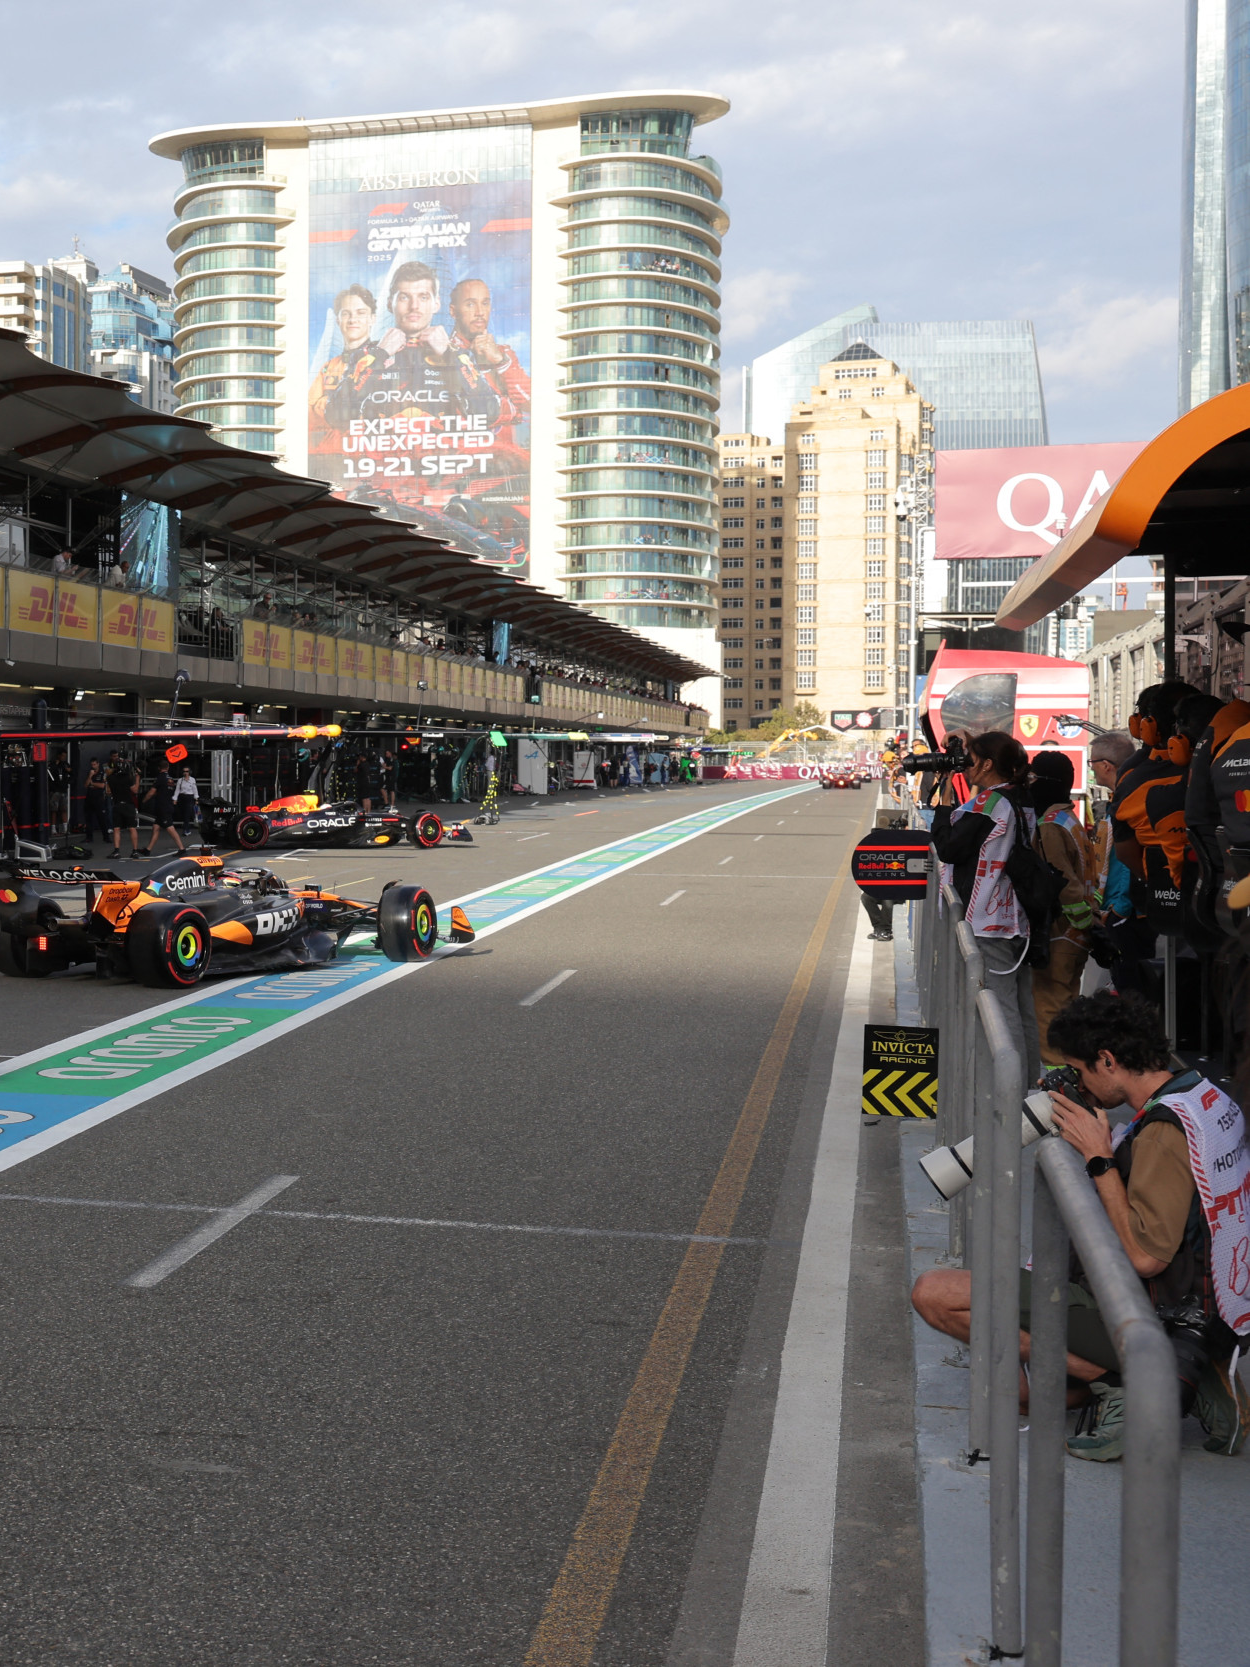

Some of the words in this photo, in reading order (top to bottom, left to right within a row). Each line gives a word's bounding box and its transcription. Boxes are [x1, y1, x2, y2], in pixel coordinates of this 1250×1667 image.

[358, 168, 480, 192] ABSHERON
[413, 200, 440, 209] QATAR
[408, 216, 430, 224] QATAR
[367, 222, 470, 240] AZERBAIJAN
[367, 237, 426, 252] GRAND
[427, 235, 468, 249] PRIX
[367, 254, 392, 262] 2025
[371, 389, 449, 403] ORACLE
[350, 416, 436, 436] EXPECT
[439, 413, 488, 432] THE
[342, 430, 495, 453] UNEXPECTED
[343, 456, 415, 479] 19-21
[421, 453, 494, 476] SEPT
[28, 585, 79, 629] DHL
[116, 603, 158, 641] DHL
[252, 630, 281, 660] DHL
[302, 639, 326, 667] DHL
[0, 704, 32, 717] RSTAPPEN
[306, 817, 356, 829] ORACLE
[859, 853, 906, 861] ORACLE
[18, 868, 98, 881] VELO.COM
[165, 871, 206, 892] Gemini
[105, 895, 121, 903] Dash
[108, 887, 133, 896] Dropbox
[1154, 887, 1181, 901] webe
[234, 960, 382, 1000] aramco
[36, 1016, 253, 1081] aramco
[871, 1040, 936, 1055] INVICTA
[879, 1056, 927, 1065] RACING
